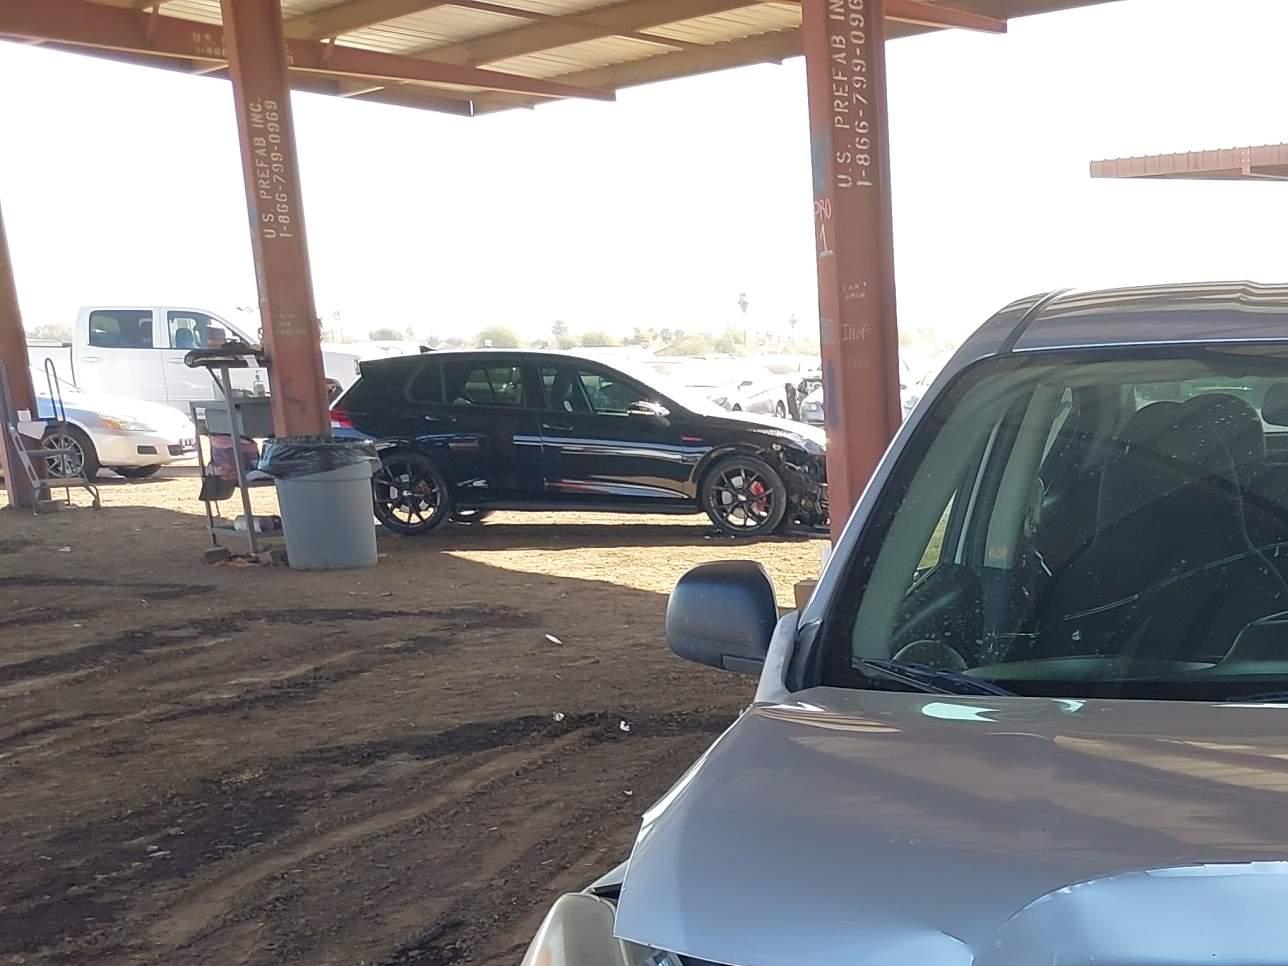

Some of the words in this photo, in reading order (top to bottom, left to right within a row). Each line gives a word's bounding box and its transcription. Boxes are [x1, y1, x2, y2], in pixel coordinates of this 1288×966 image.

[830, 35, 850, 129] PREFAB
[249, 97, 265, 129] INC.
[253, 136, 273, 200] PREFAB
[264, 99, 293, 238] 1-866-799-0969
[835, 144, 852, 188] U.S.
[262, 209, 277, 239] U.S.
